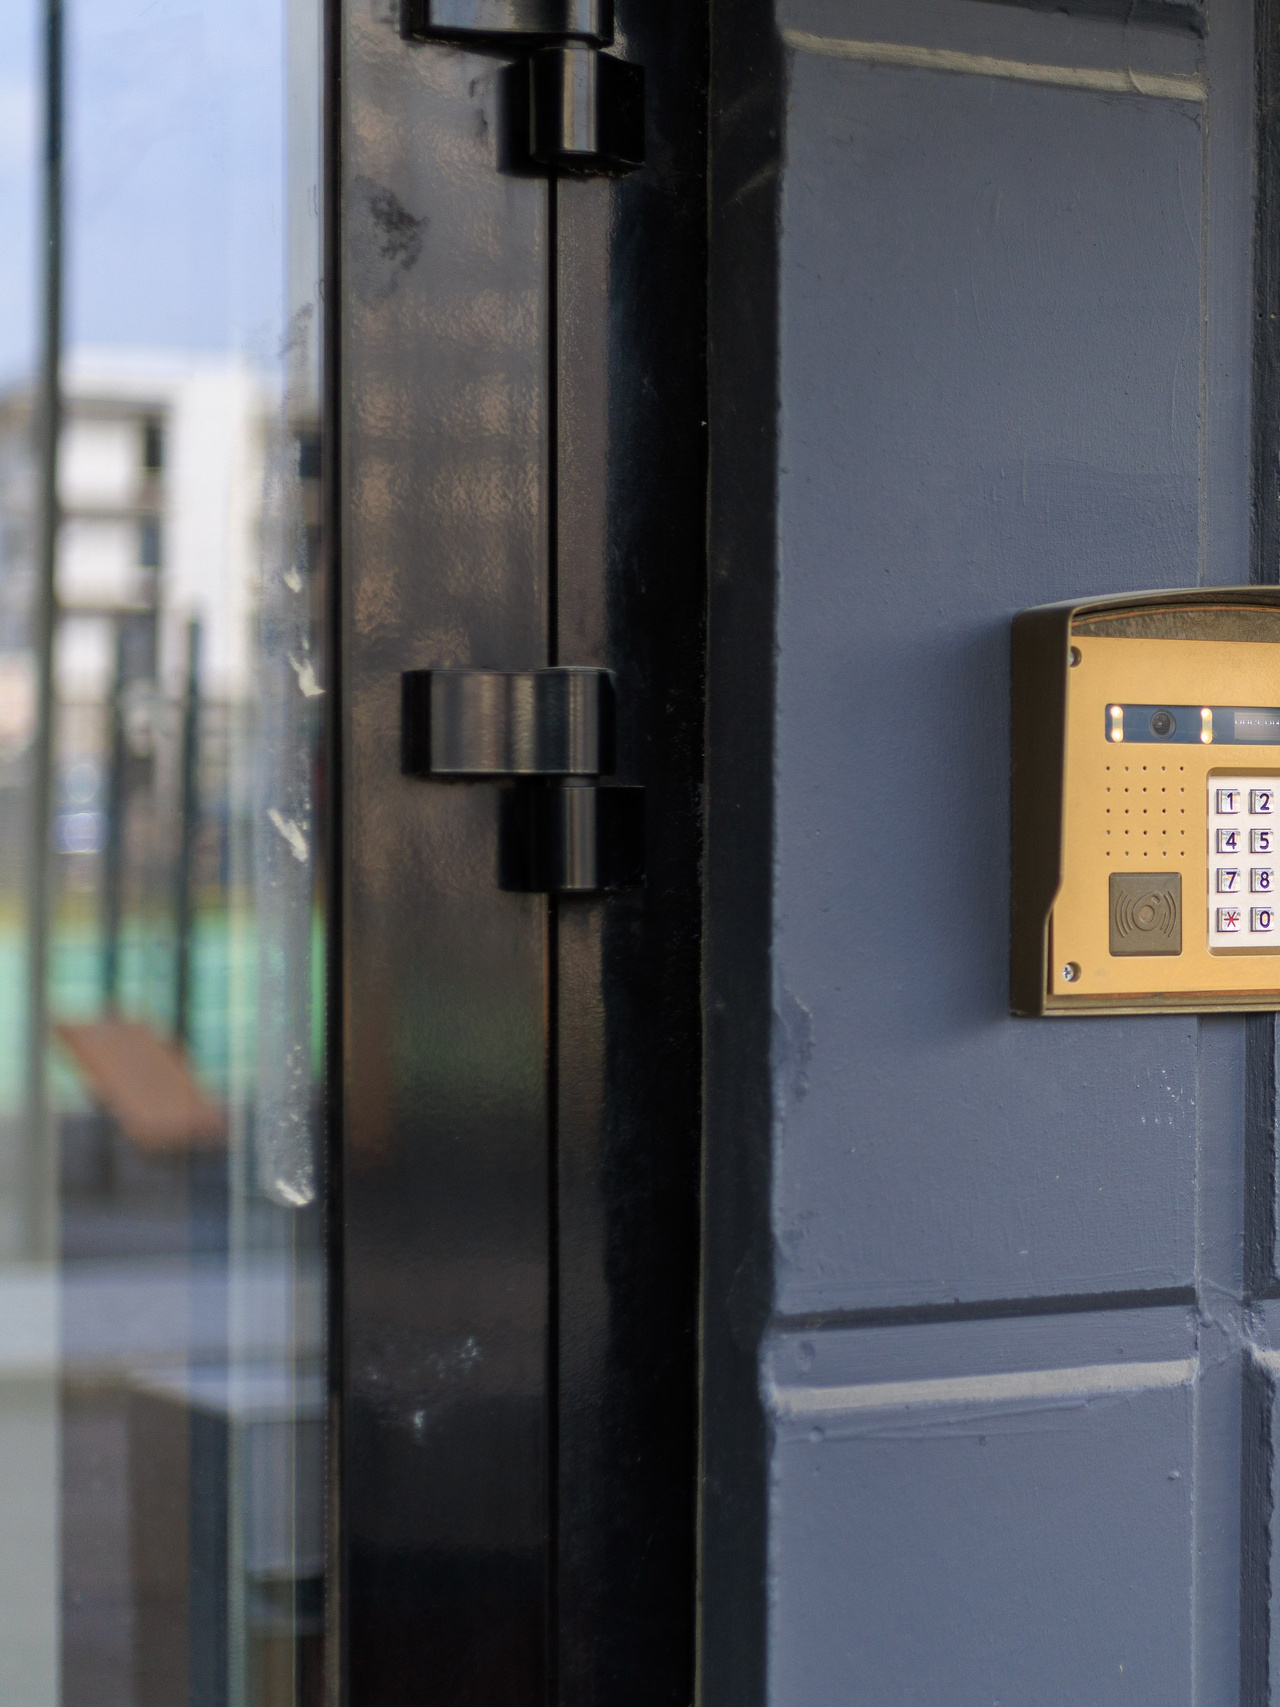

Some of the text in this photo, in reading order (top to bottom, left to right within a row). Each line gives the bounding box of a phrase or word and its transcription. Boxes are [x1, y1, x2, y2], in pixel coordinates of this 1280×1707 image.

[1226, 792, 1234, 811] 1
[1259, 792, 1270, 811] 2
[1225, 831, 1237, 850] 4
[1259, 831, 1270, 850] 5
[1226, 871, 1237, 890] 7
[1259, 871, 1270, 890] 8
[1259, 910, 1271, 929] 0
